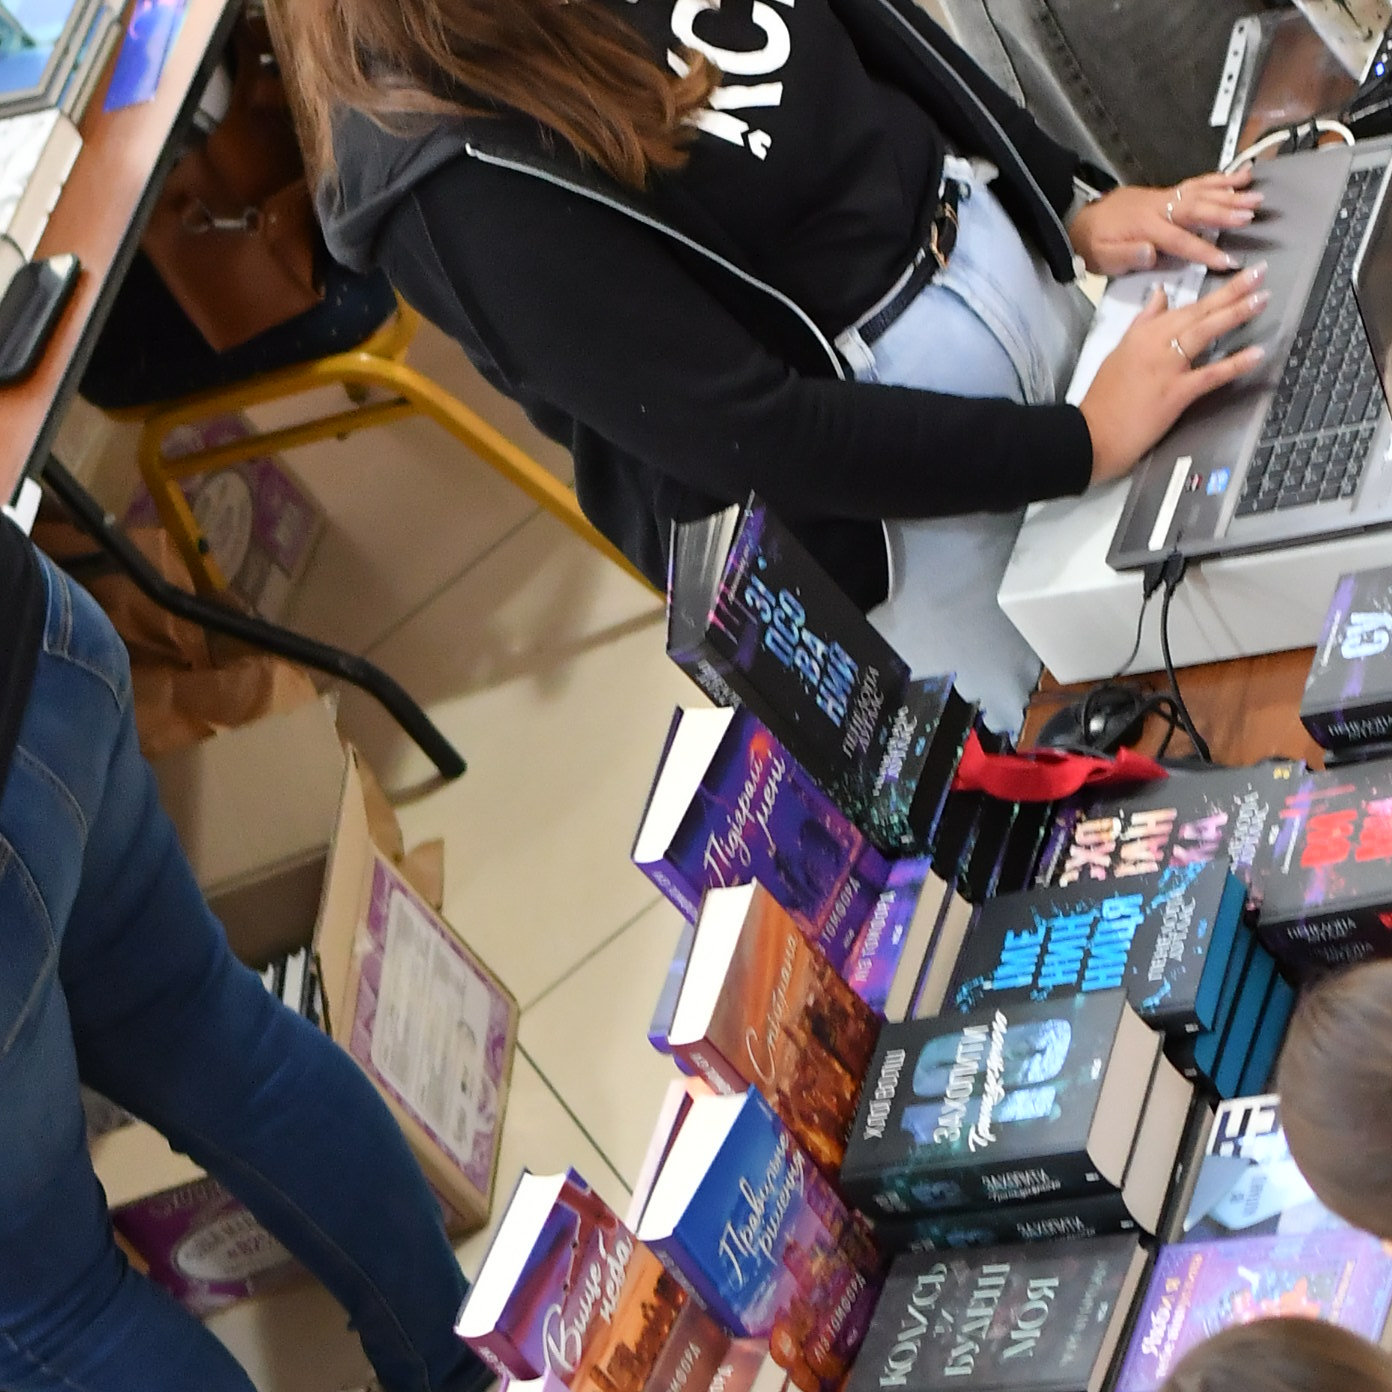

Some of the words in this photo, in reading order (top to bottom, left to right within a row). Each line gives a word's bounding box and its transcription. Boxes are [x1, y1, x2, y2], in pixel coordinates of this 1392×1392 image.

[763, 588, 808, 655] ПСО
[794, 629, 831, 687] ВА
[815, 641, 860, 726] НИЙ
[984, 922, 1049, 991] ІМЕ
[1037, 912, 1096, 988] НИН
[1081, 892, 1146, 991] НИЦЯ
[931, 1024, 989, 1146] ЗАХОПИТИ
[543, 1263, 603, 1377] Вище
[879, 1261, 950, 1388] КОЛИСЬ
[943, 1262, 1012, 1377] БУДЕШ
[1002, 1276, 1060, 1361] МОЯ
